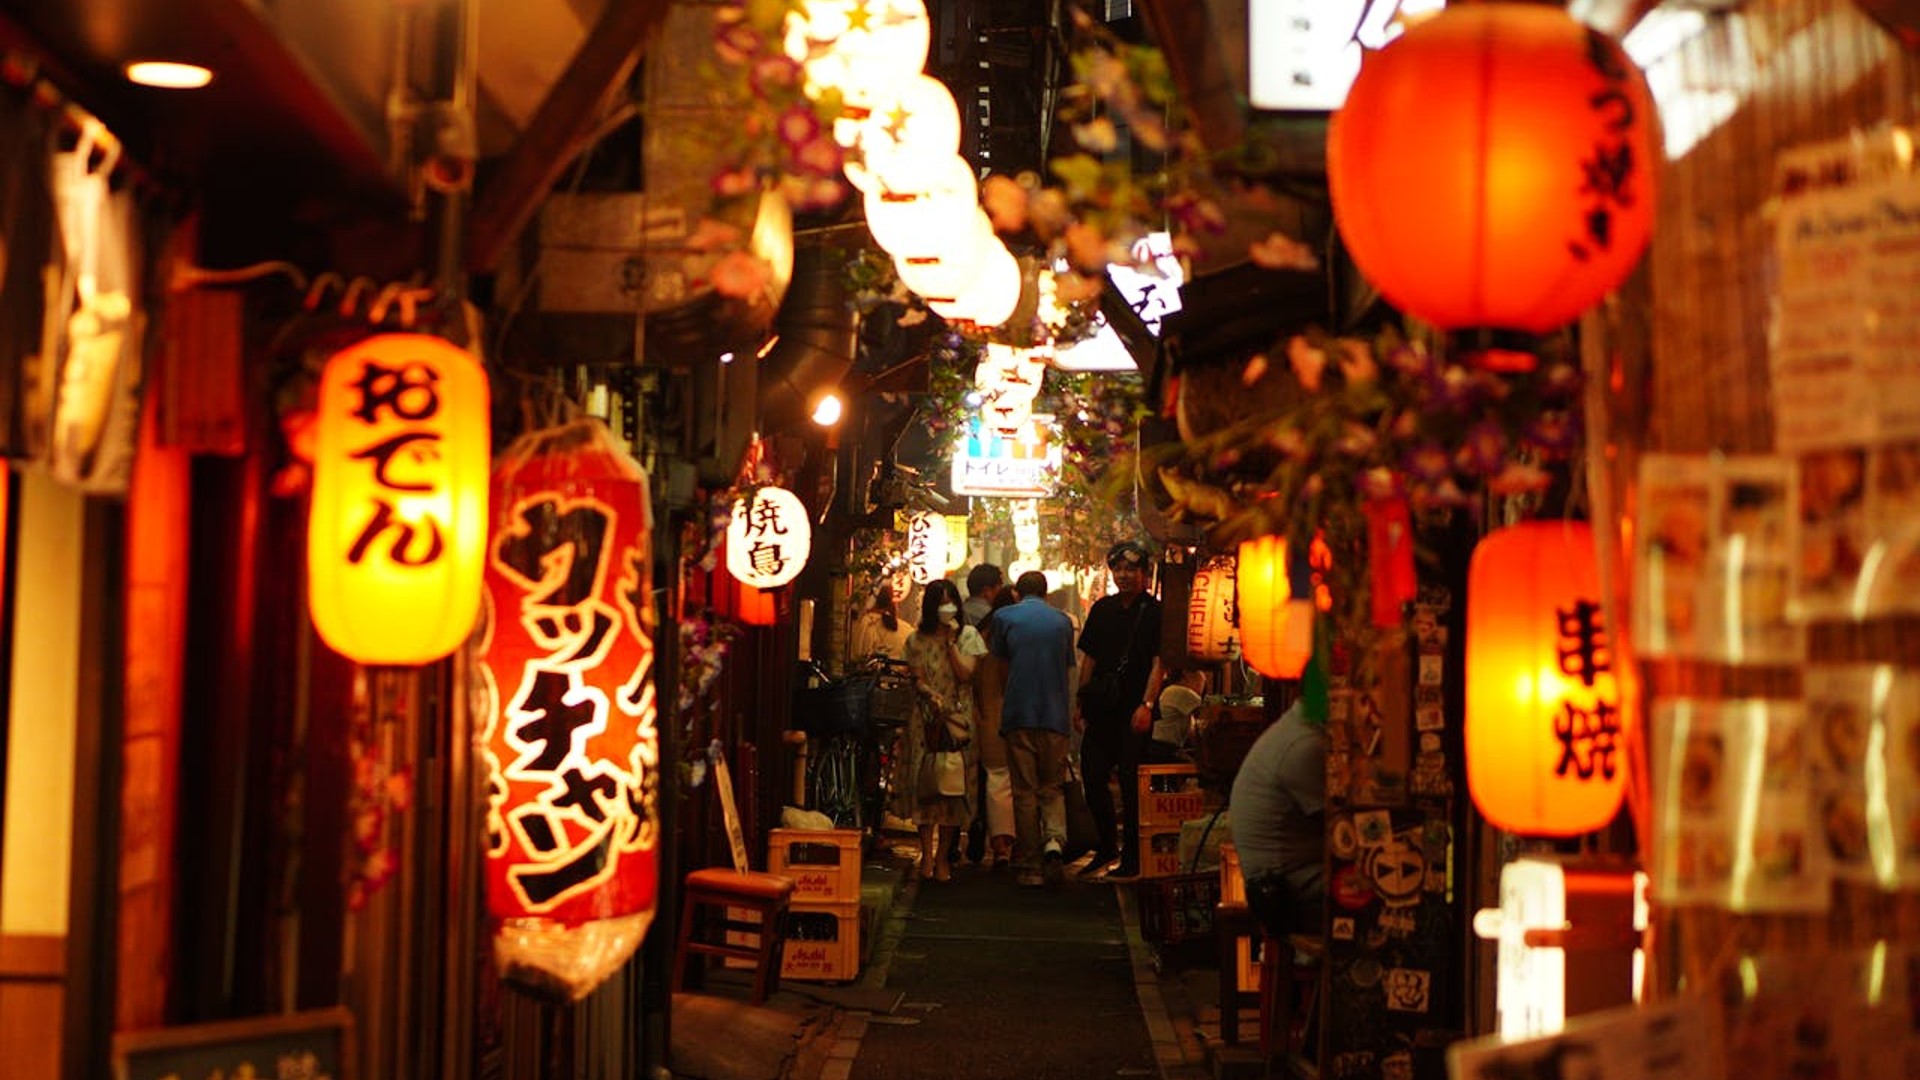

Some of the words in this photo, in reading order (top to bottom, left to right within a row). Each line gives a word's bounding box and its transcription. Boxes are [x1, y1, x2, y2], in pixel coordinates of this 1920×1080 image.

[347, 362, 444, 566] おでん
[963, 461, 1009, 476] トイレ
[738, 497, 788, 579] 焼鳥
[1555, 599, 1619, 779] 串焼
[798, 874, 828, 886] Asahi
[792, 948, 826, 963] Asahi
